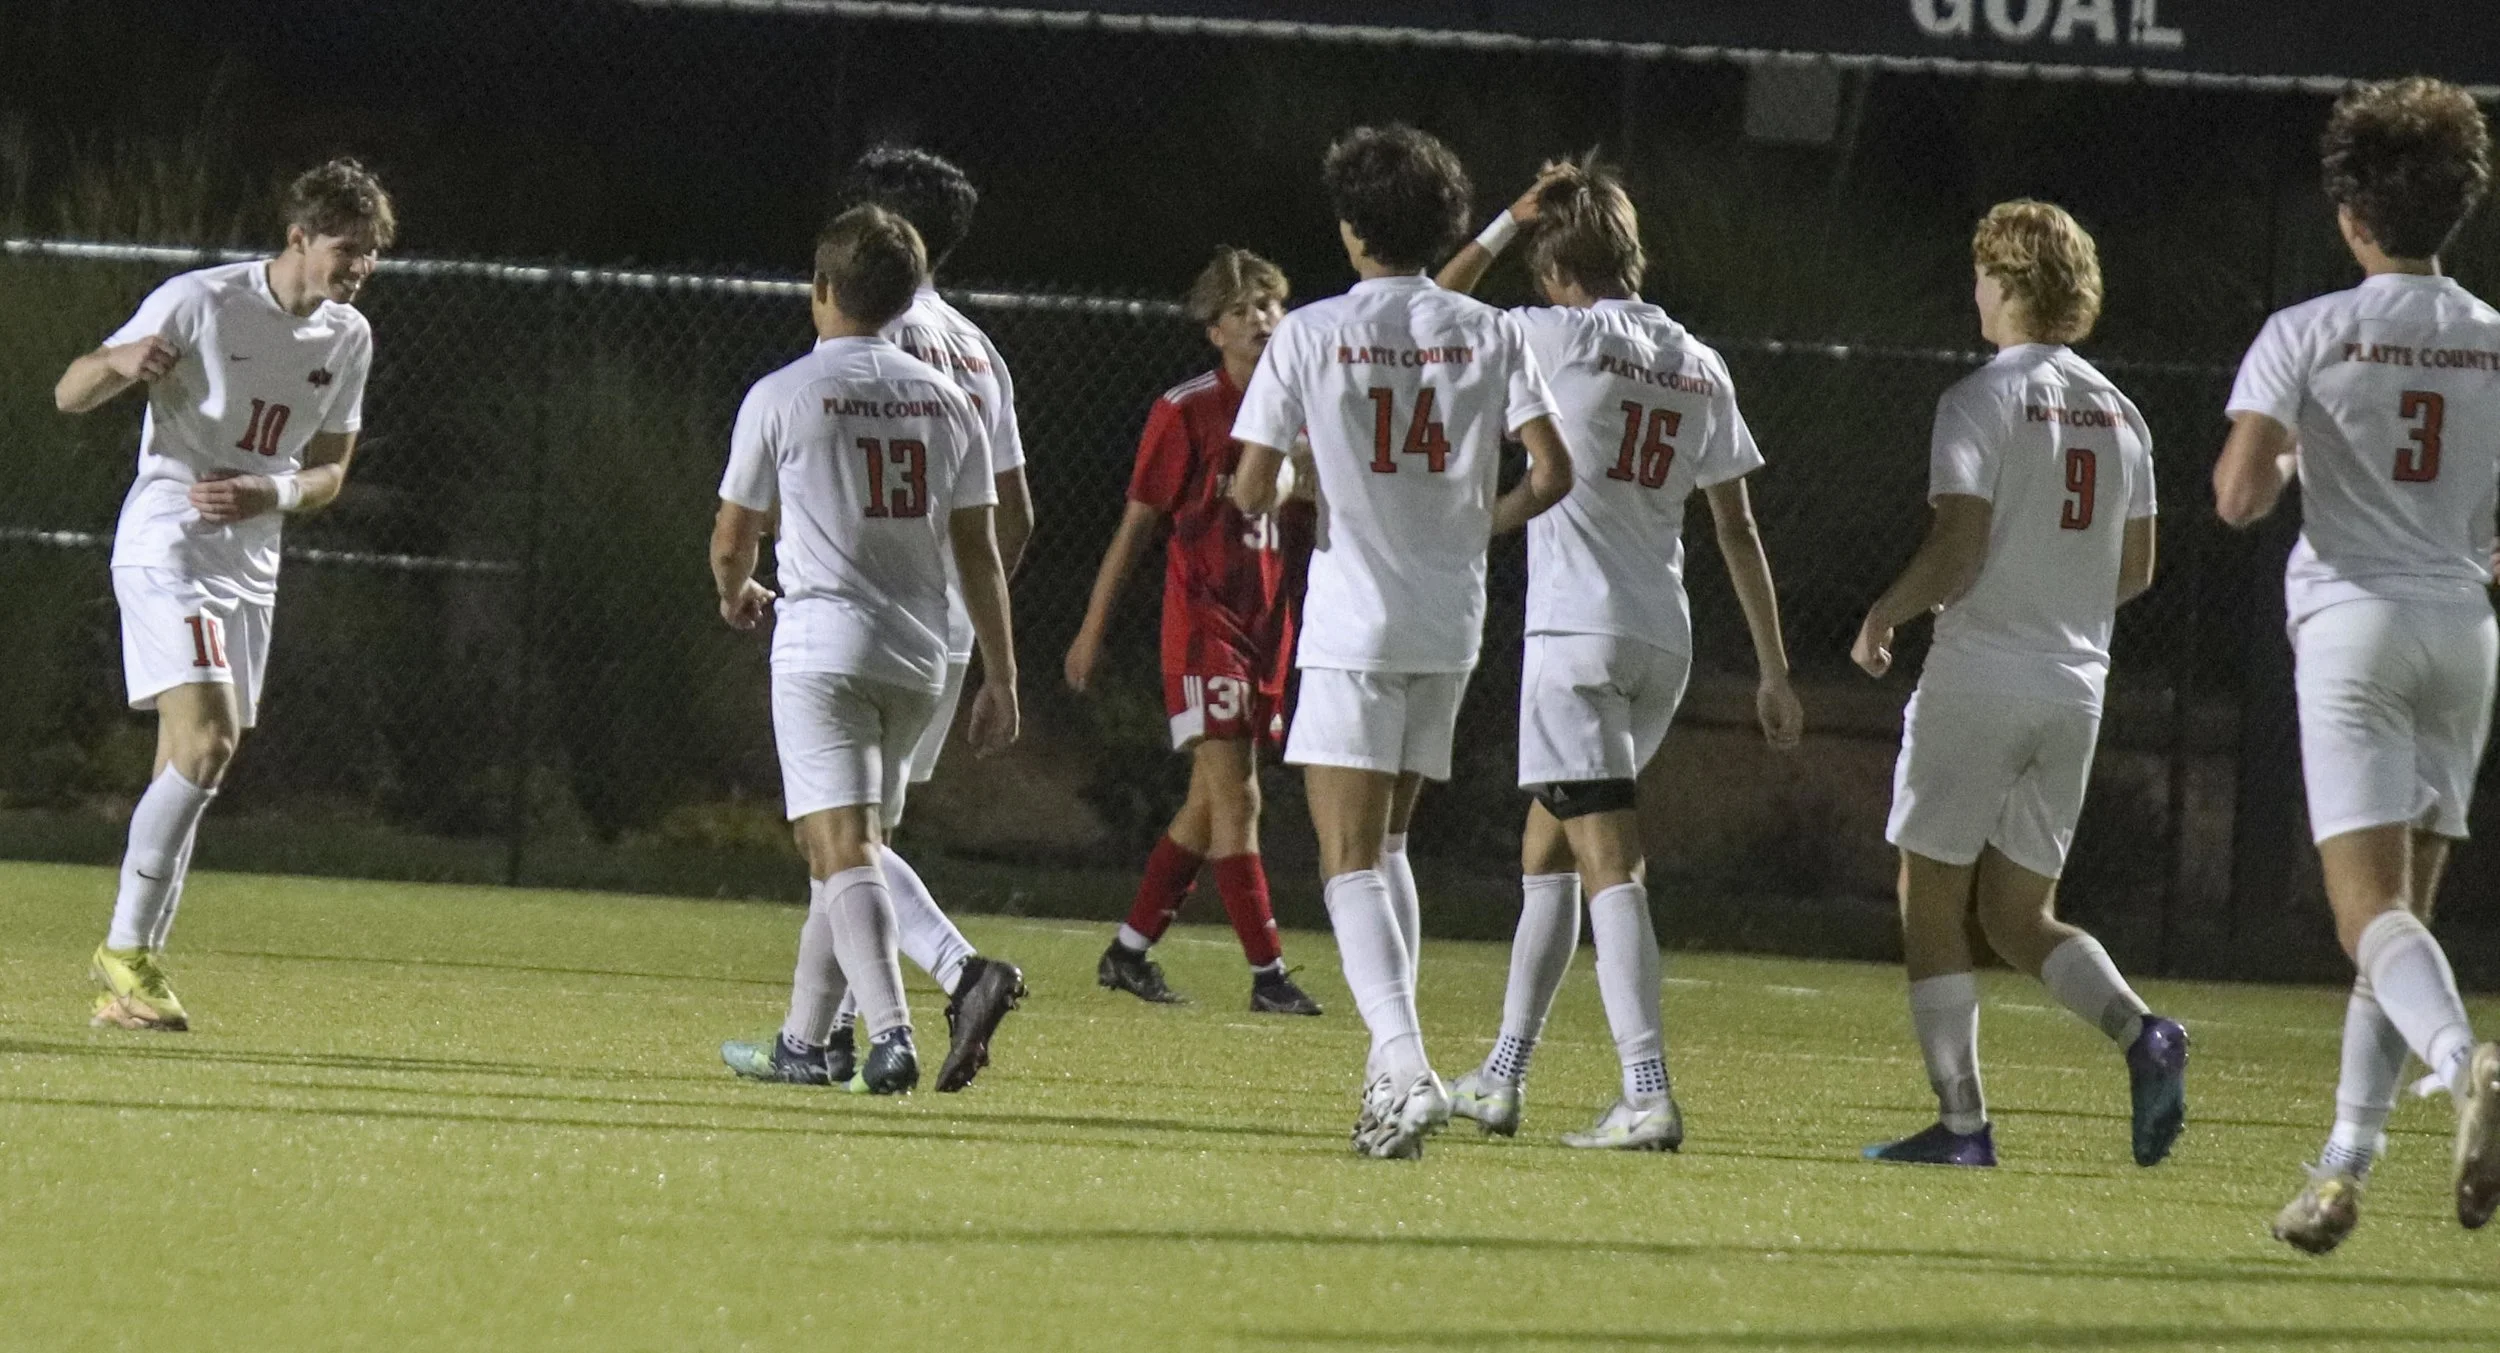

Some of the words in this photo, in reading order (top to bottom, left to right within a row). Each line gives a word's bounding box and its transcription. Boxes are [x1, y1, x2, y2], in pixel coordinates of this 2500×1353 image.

[1337, 346, 1397, 367] PLATTE
[1401, 347, 1474, 368] COUNTY
[1656, 371, 1713, 396] COUNTY
[236, 398, 291, 456] 10
[1368, 387, 1451, 473] 14
[1607, 400, 1682, 489] 16
[2392, 390, 2444, 482] 3
[857, 437, 927, 518] 13
[2061, 448, 2096, 530] 9
